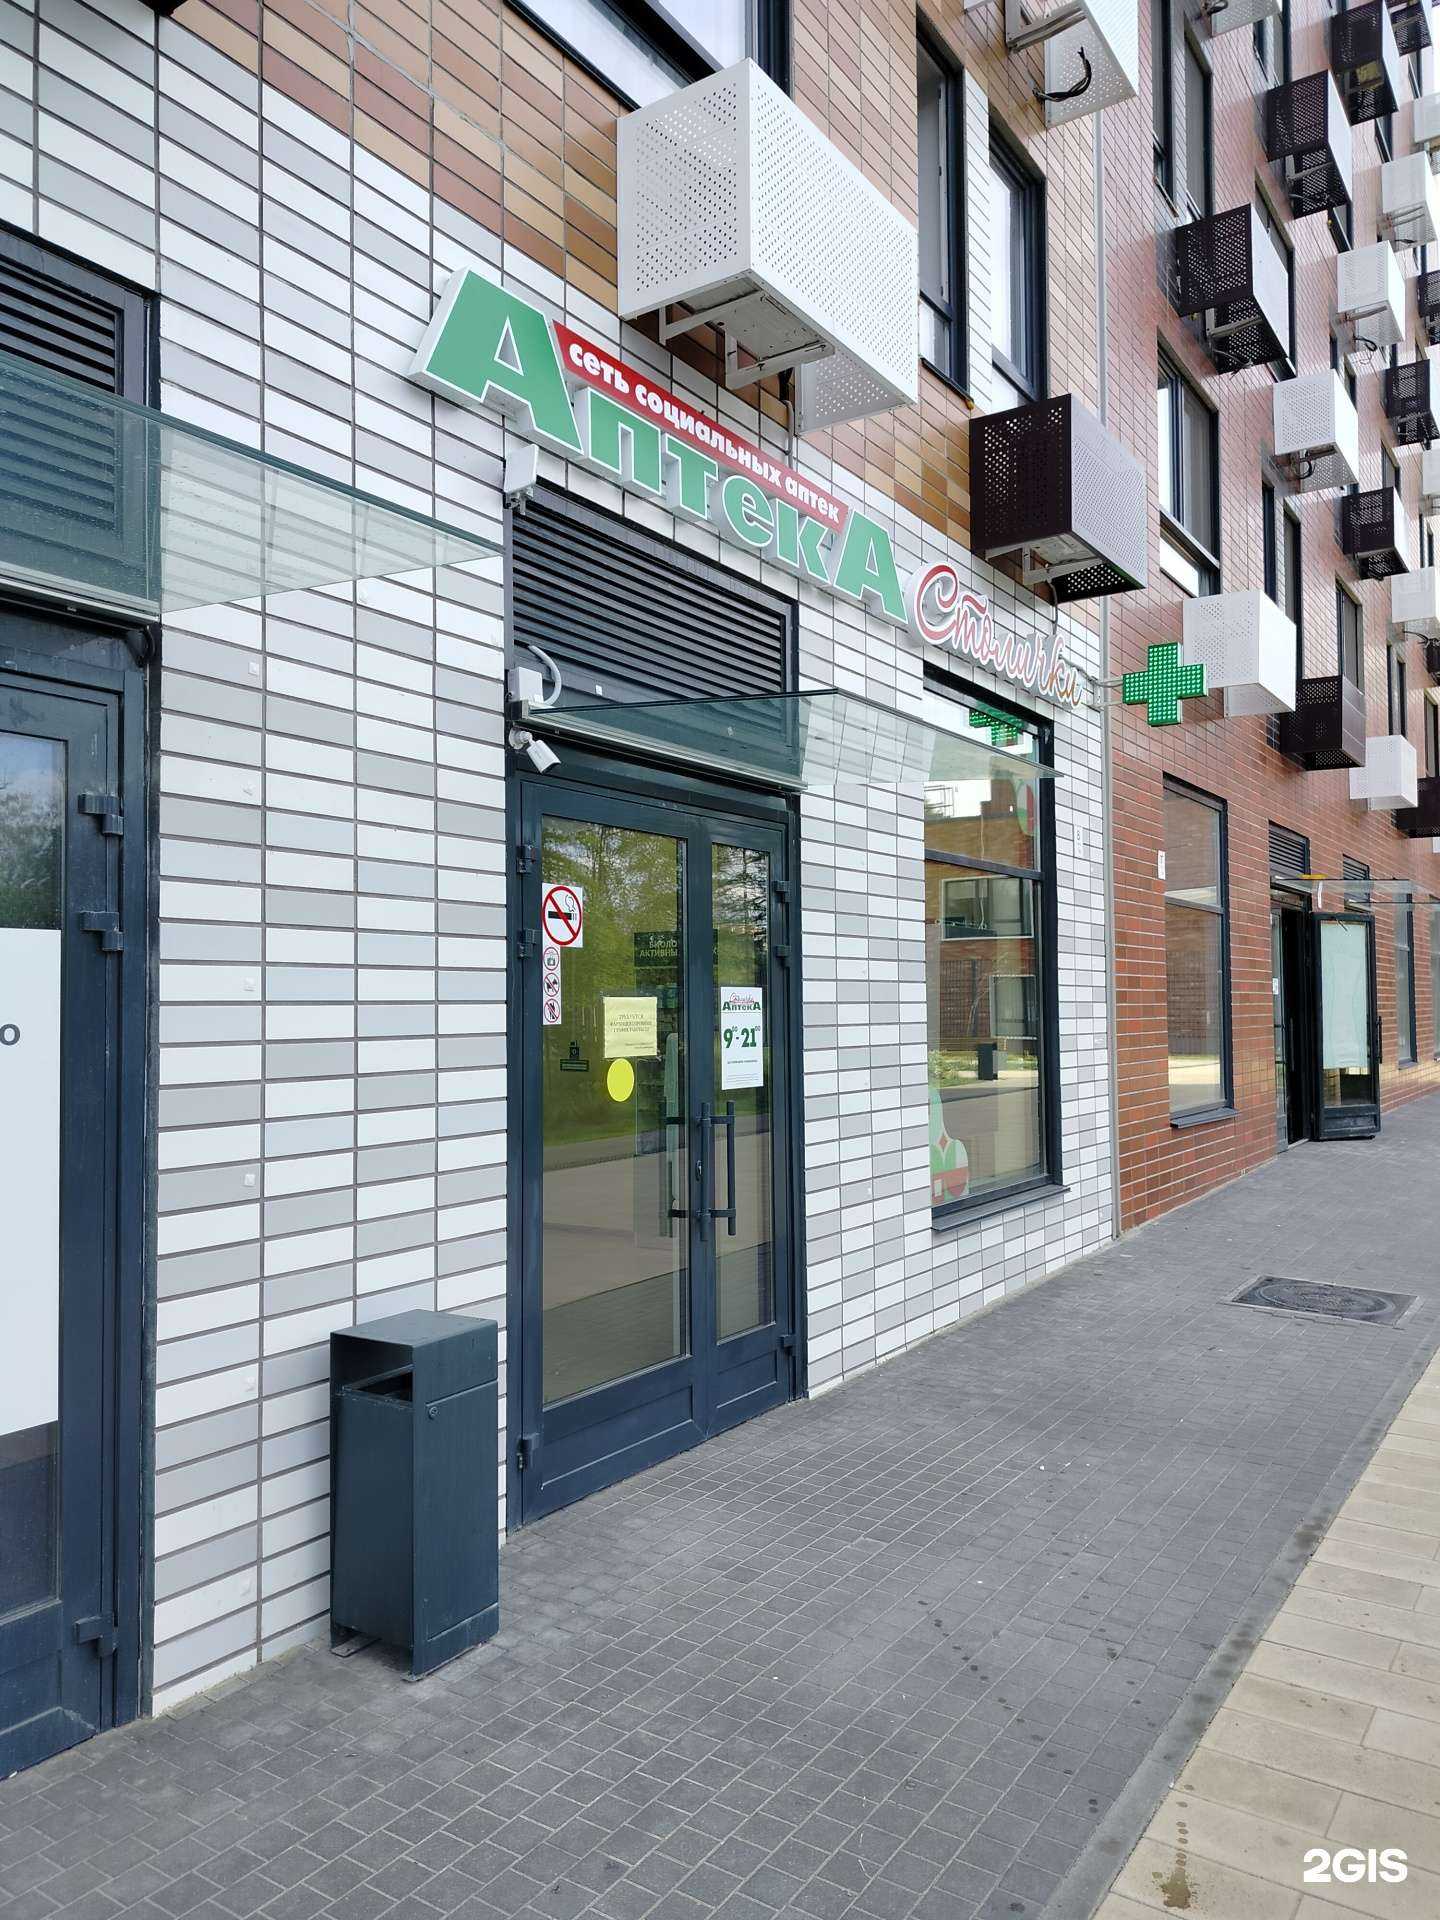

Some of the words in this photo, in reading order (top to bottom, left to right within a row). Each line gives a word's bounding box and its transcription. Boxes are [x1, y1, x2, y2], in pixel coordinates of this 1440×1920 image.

[569, 342, 630, 394] сеть
[635, 383, 783, 489] социальных
[784, 475, 840, 524] аптек
[913, 563, 1084, 708] Столички
